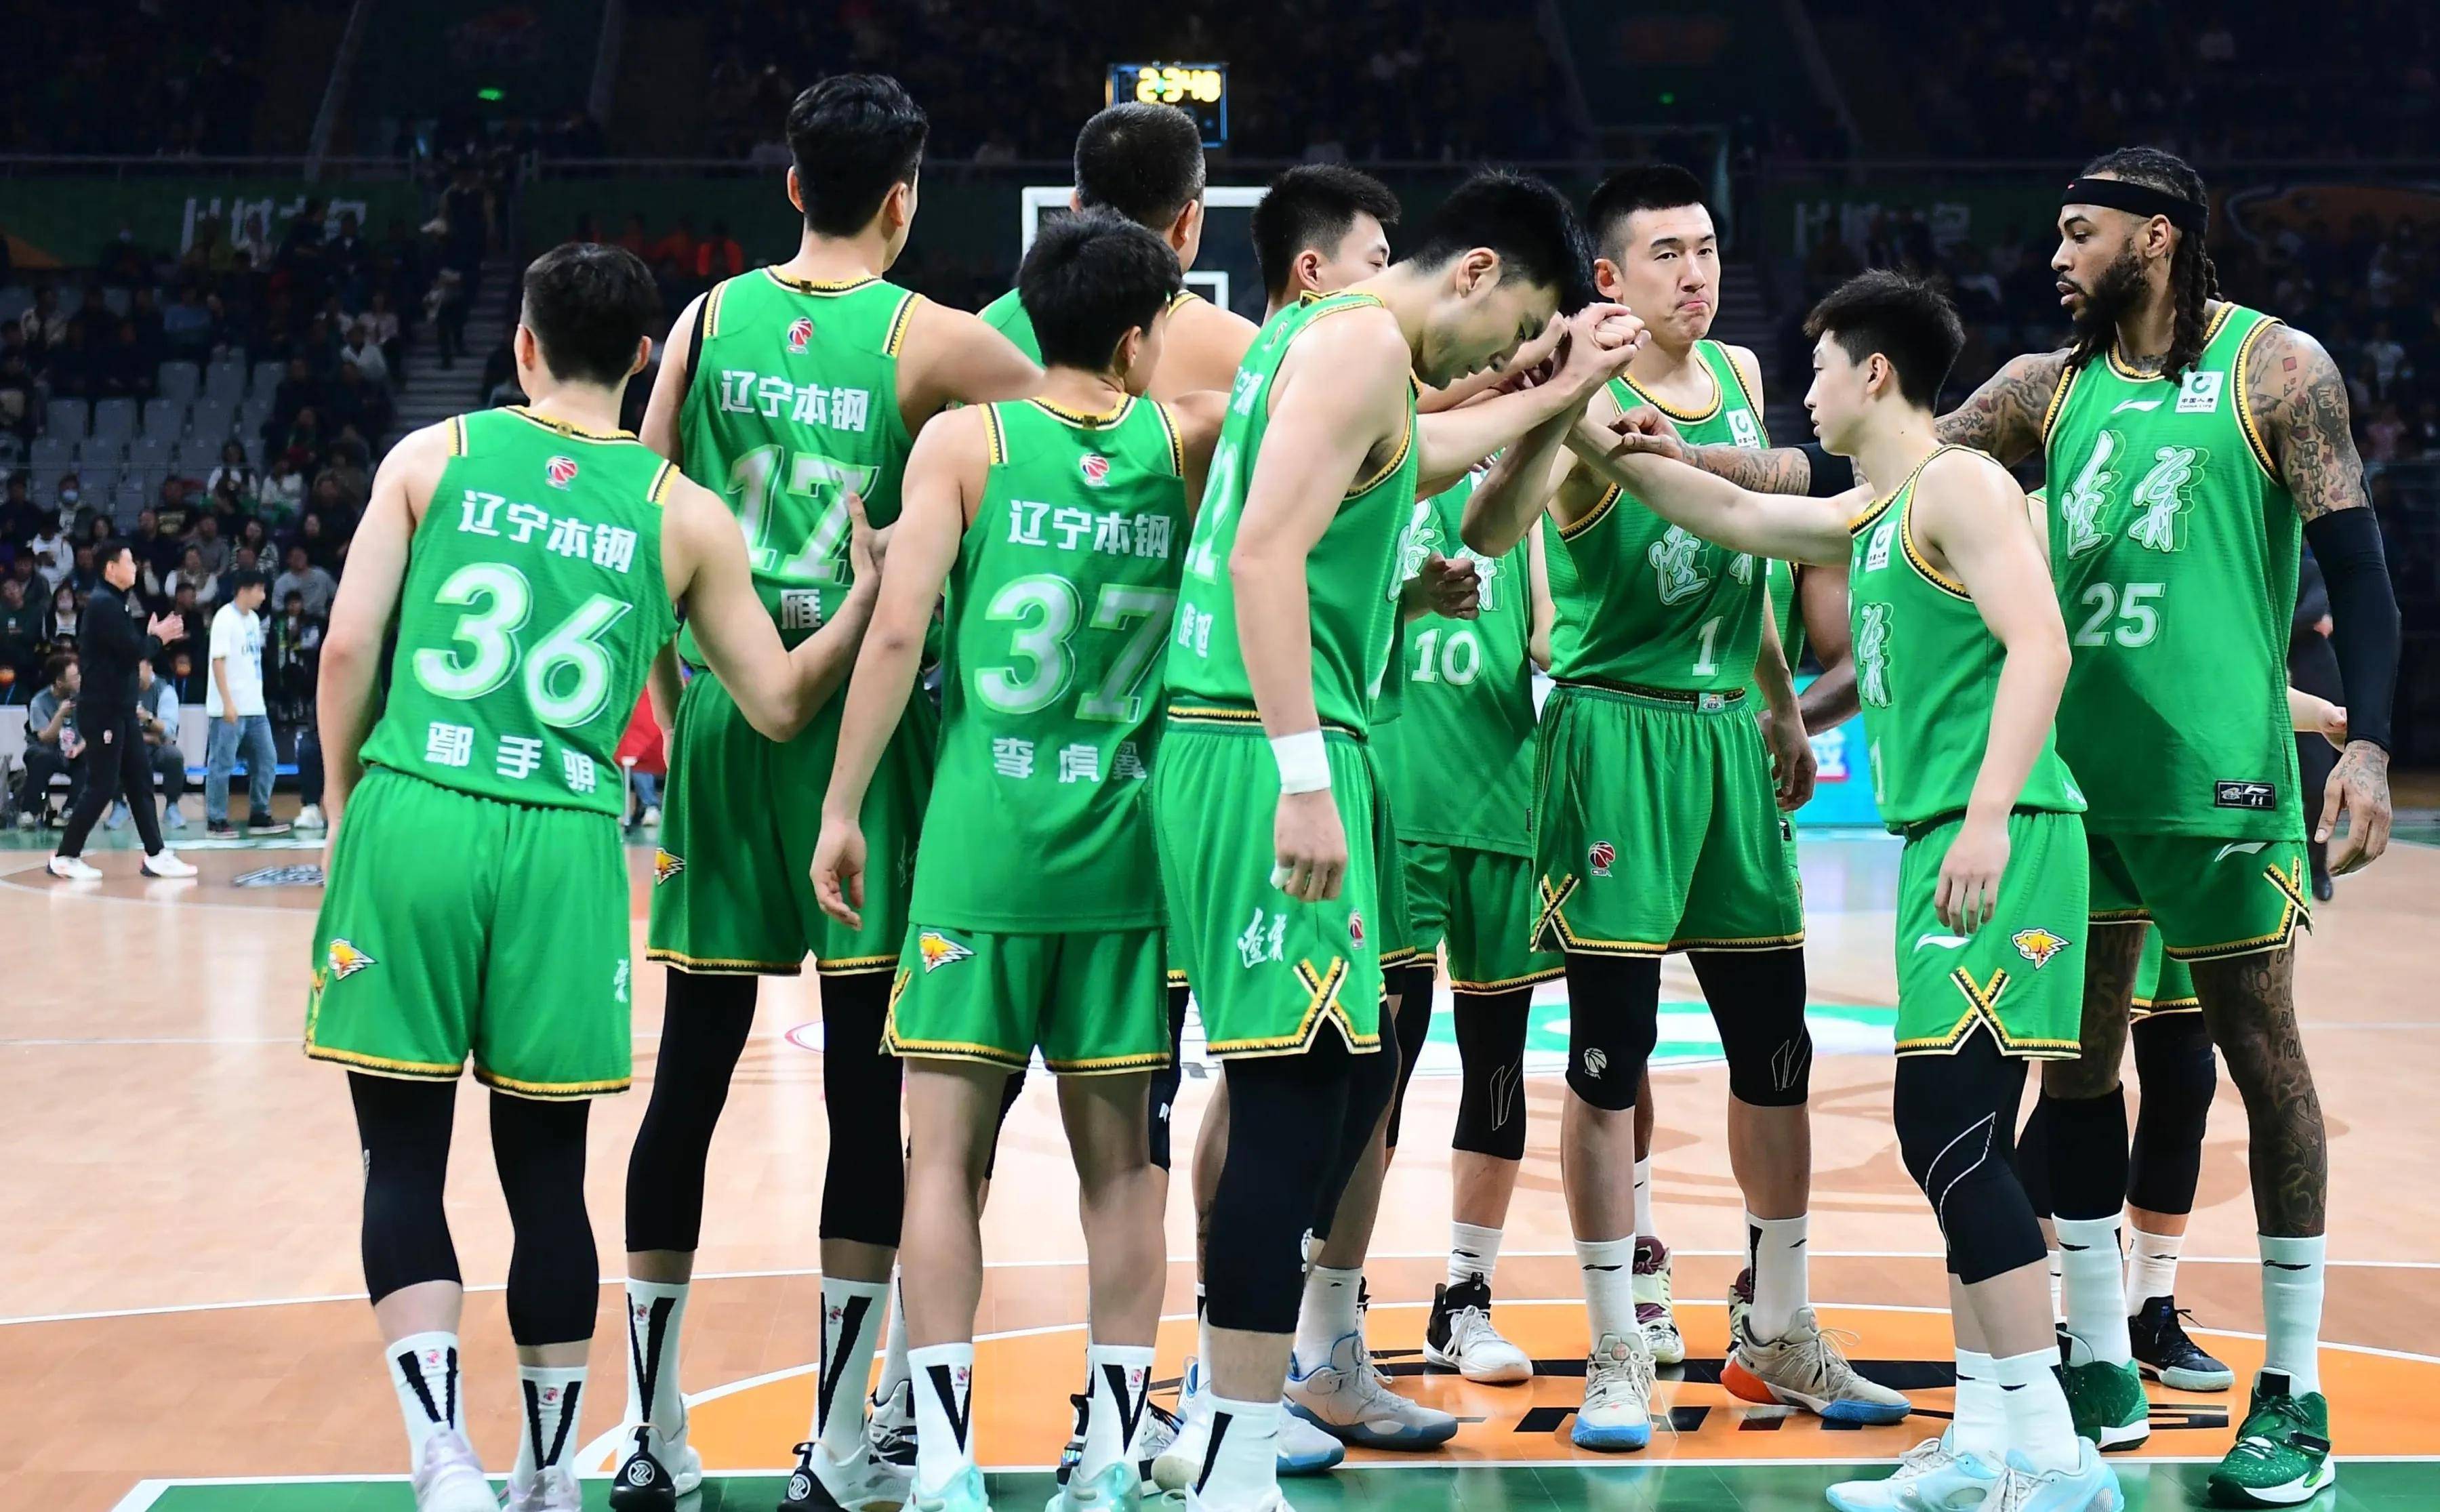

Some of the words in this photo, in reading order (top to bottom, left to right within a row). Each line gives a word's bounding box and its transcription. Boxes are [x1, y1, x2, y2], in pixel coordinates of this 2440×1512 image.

[720, 370, 869, 432] 辽宁本钢
[457, 489, 638, 574] 辽宁本钢
[726, 444, 880, 585] 17
[1007, 499, 1171, 559] 辽宁本钢
[412, 561, 633, 728] 36
[1692, 616, 1724, 676] 1
[2074, 582, 2166, 648] 25
[974, 573, 1179, 724] 37
[1411, 628, 1483, 686] 10
